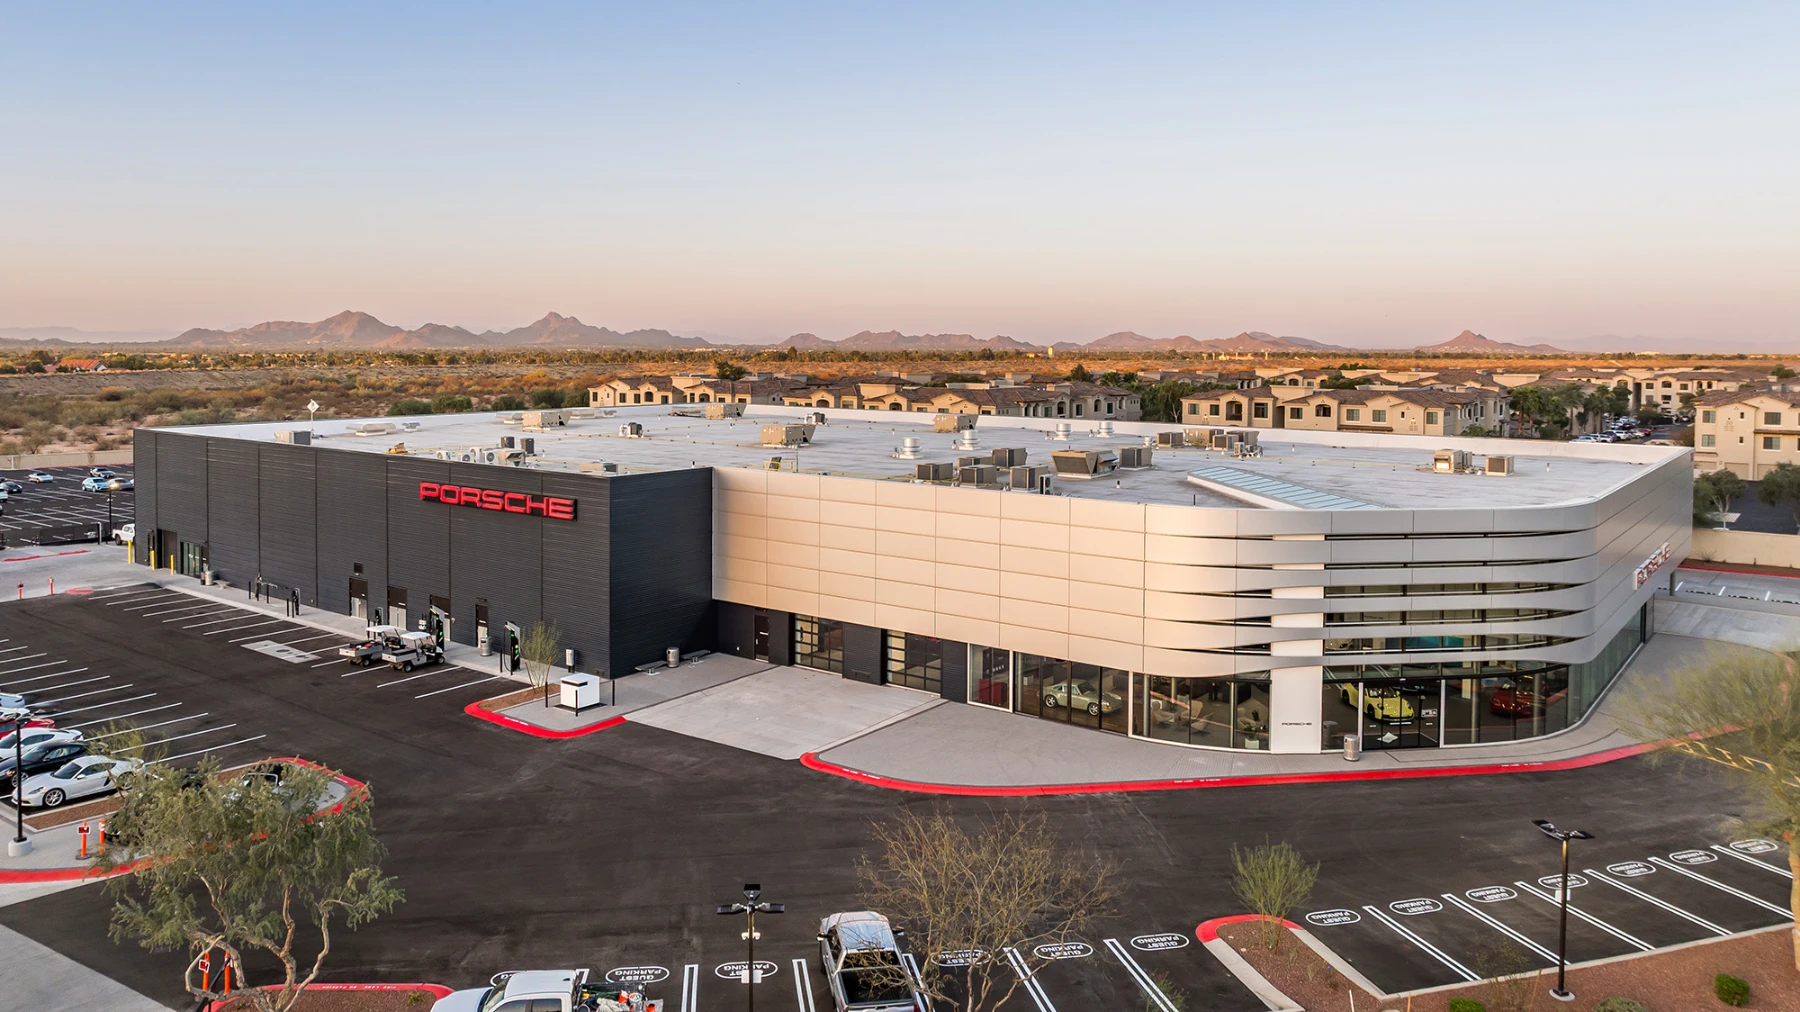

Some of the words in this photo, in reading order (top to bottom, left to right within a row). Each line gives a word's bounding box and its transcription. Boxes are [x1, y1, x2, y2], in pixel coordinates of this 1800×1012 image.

[420, 482, 574, 520] PORSCHE
[1394, 900, 1432, 909] PARKING
[1311, 911, 1350, 919] PARKING
[1137, 936, 1180, 944] PARKING
[1147, 941, 1178, 949] GUEST
[723, 963, 770, 971] PAKING
